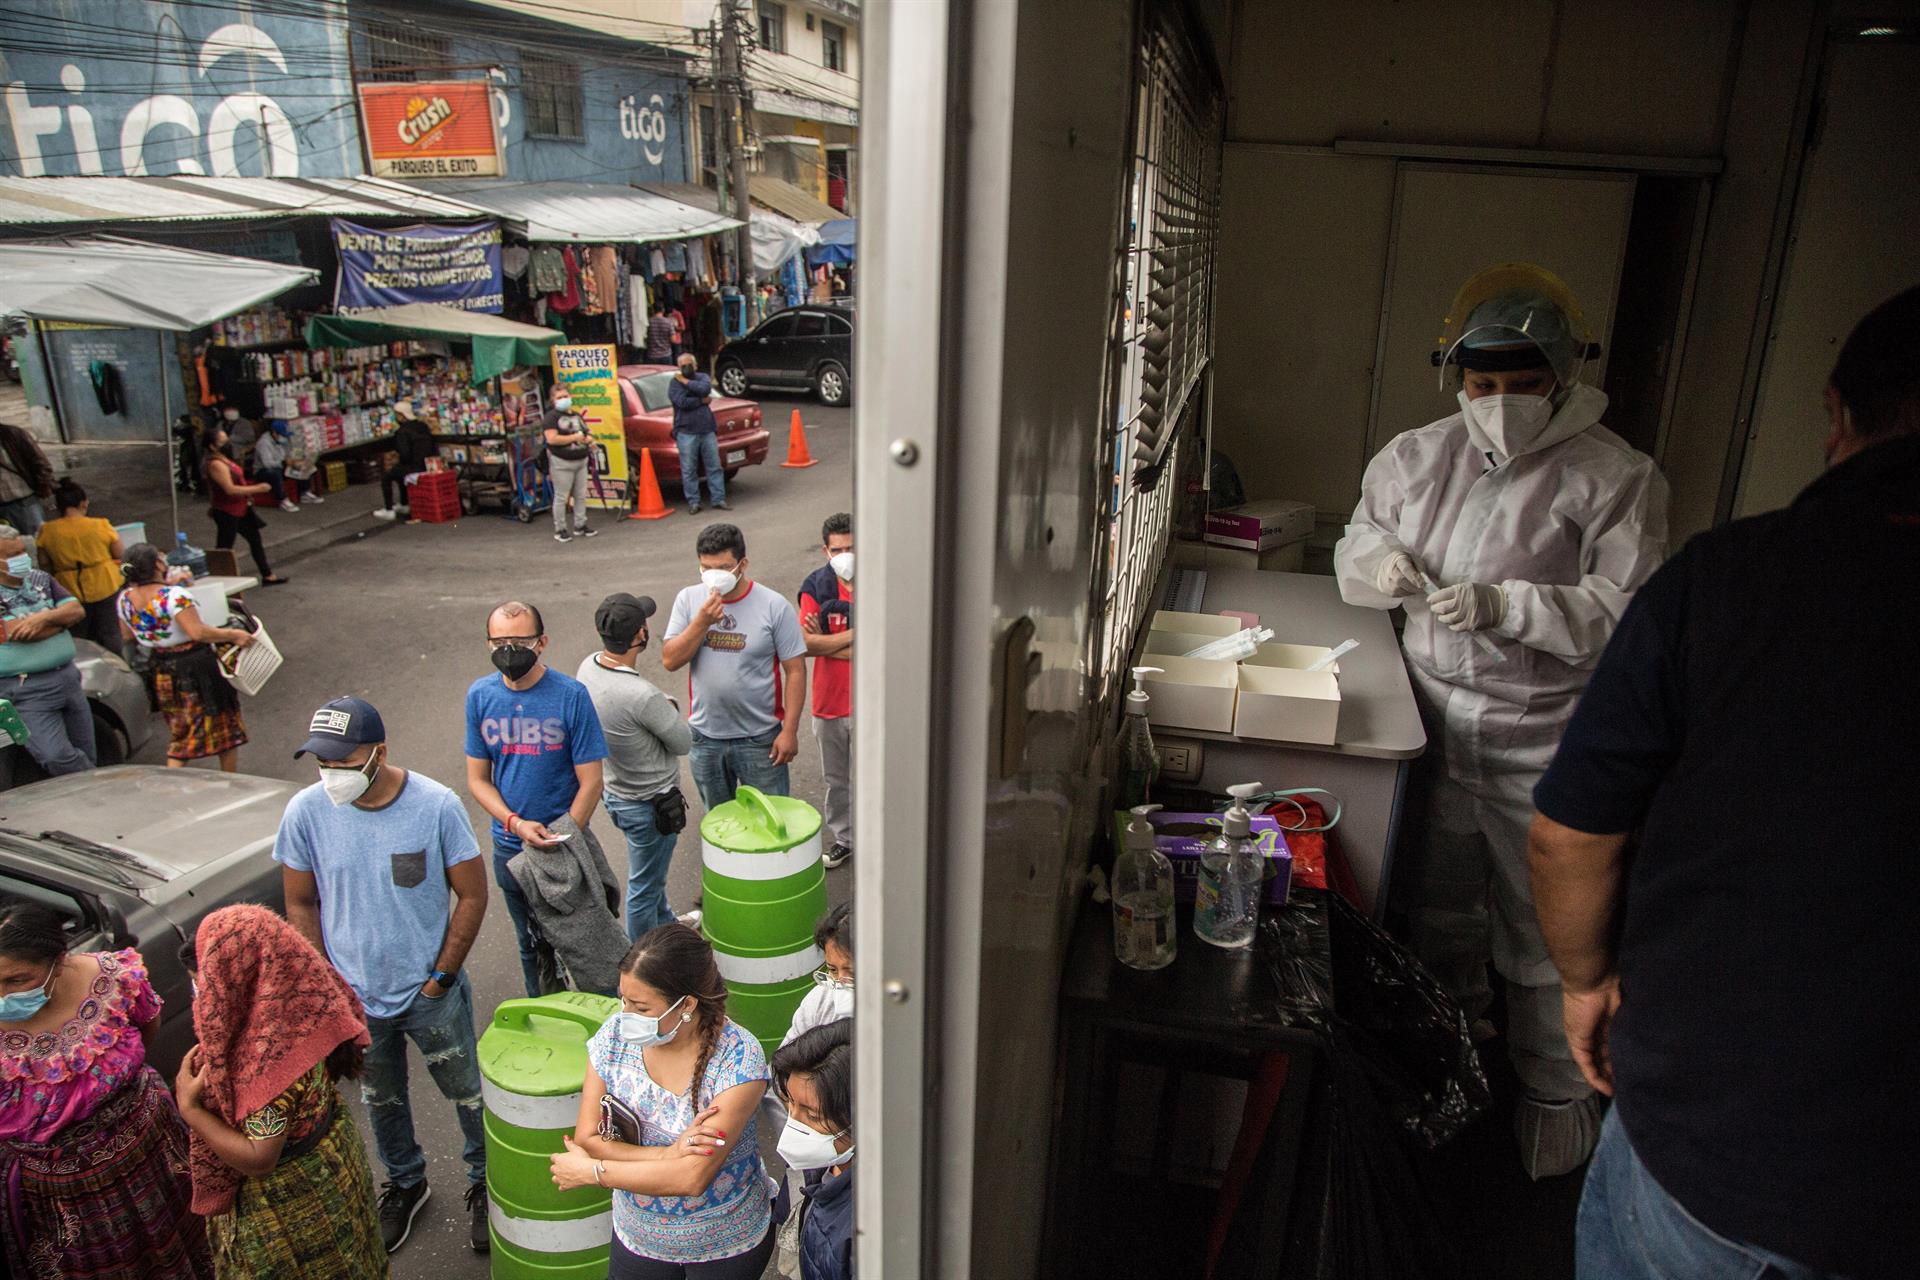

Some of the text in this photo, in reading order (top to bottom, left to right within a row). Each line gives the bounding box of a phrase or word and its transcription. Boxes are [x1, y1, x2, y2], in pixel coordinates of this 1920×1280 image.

[398, 97, 451, 144] Crush
[391, 161, 434, 174] PARQUEO
[437, 159, 448, 173] EL
[337, 233, 383, 252] VENTA
[374, 254, 400, 270] POR
[363, 264, 493, 289] PRECIOS COMPETITIVOS
[556, 348, 609, 359] PARQUEO
[560, 357, 609, 369] EL EXITO
[481, 717, 565, 746] CUBS
